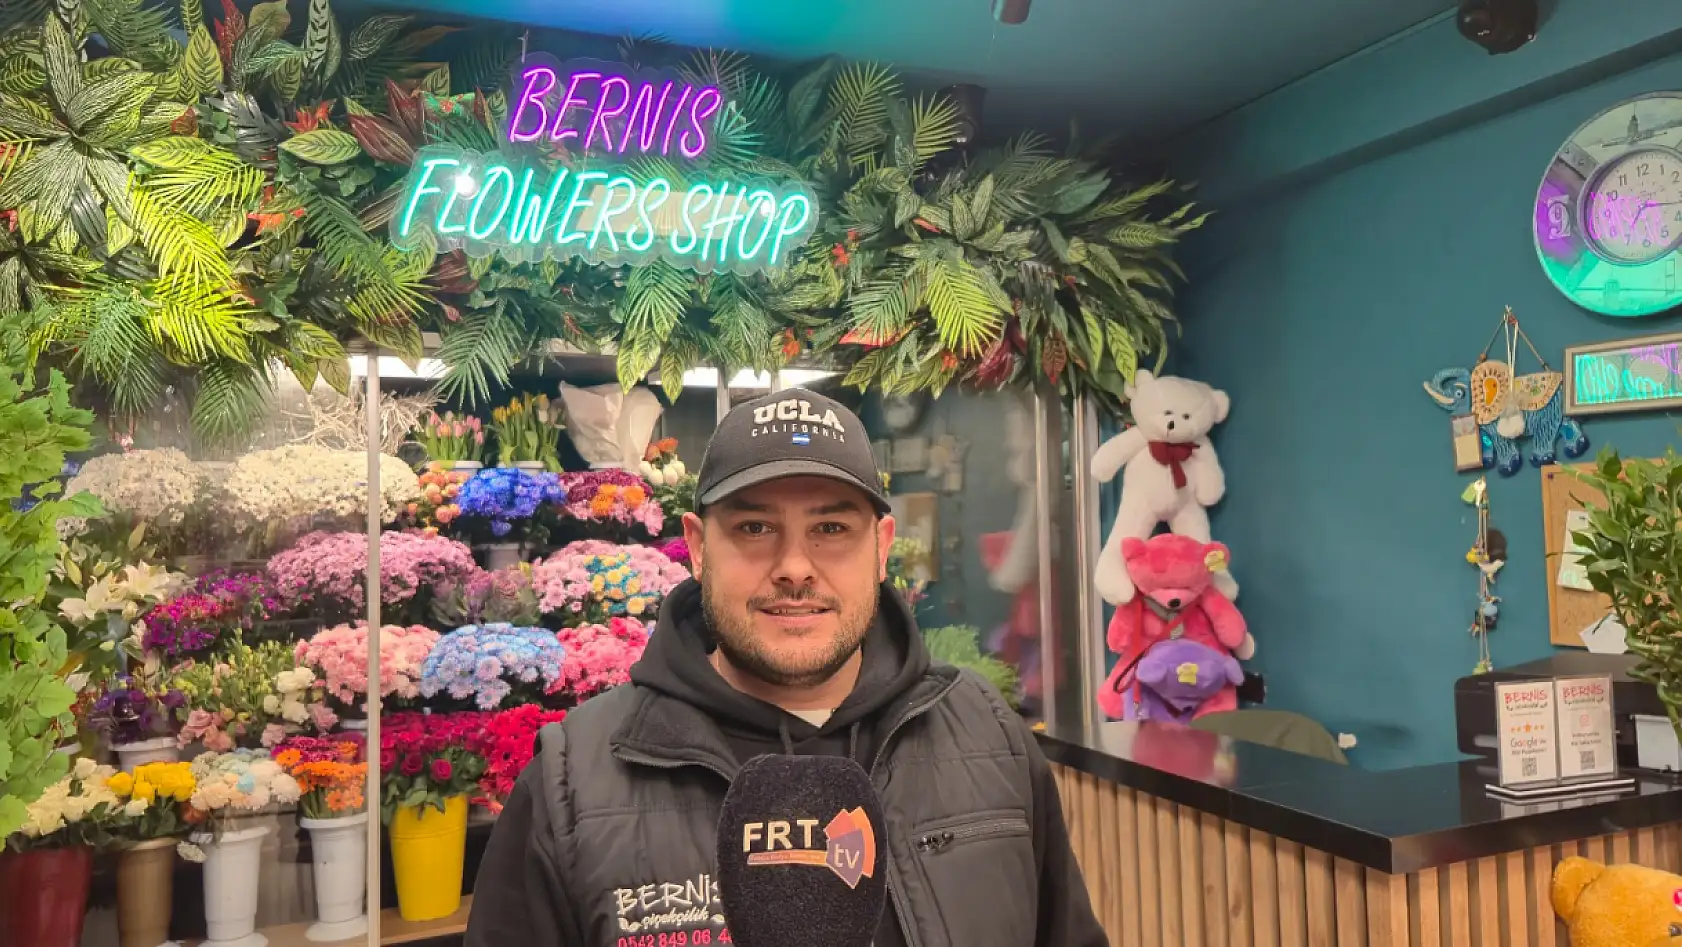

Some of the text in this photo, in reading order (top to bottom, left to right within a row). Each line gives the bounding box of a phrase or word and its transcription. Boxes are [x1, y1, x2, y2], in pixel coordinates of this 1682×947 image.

[509, 66, 723, 159] BERNIS
[1618, 174, 1628, 187] 11
[1636, 163, 1650, 177] 12
[1671, 170, 1681, 184] 2
[401, 158, 812, 265] FLOWERS SHOP
[1548, 201, 1571, 239] 9
[753, 399, 845, 433] UCLA
[751, 423, 845, 444] CALIFORNIA
[742, 819, 860, 869] FRT tv
[658, 931, 688, 947] 849
[691, 928, 711, 945] 06
